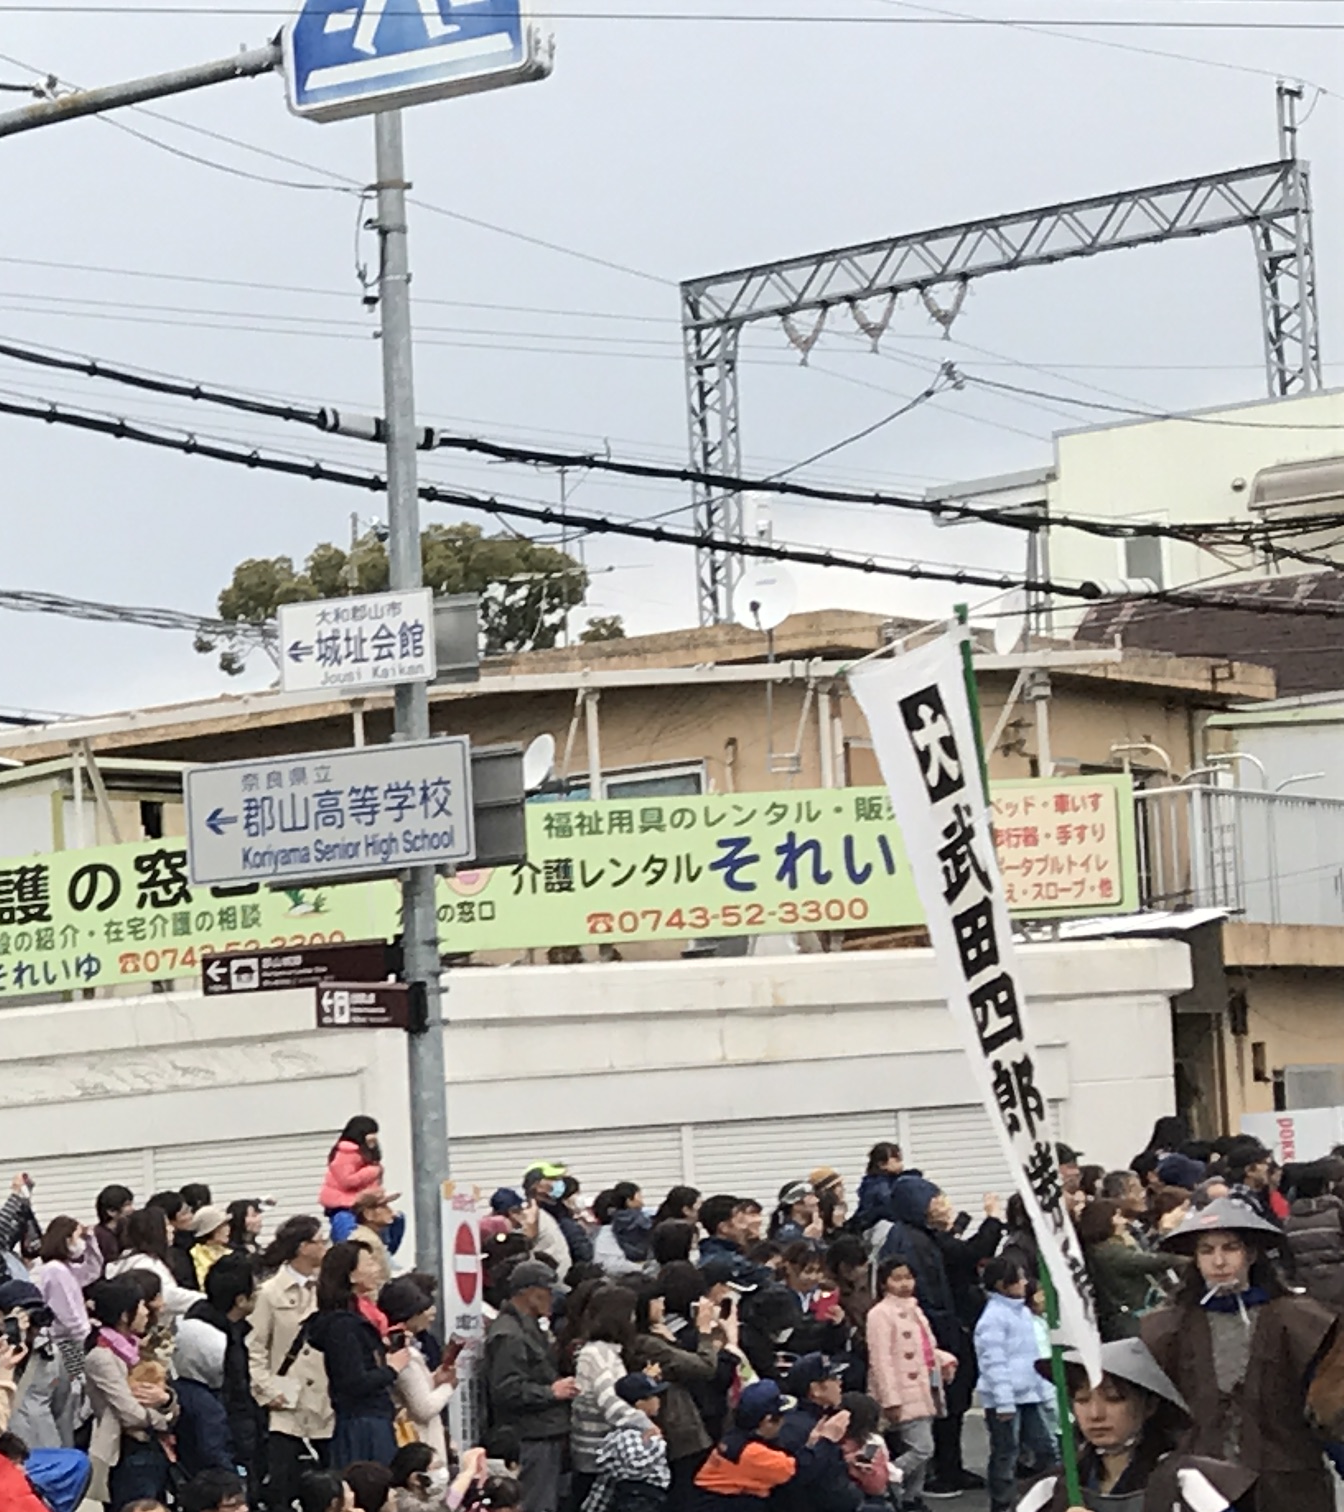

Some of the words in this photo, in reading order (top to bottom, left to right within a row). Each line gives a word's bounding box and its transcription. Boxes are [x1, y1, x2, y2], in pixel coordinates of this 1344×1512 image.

[315, 600, 403, 626] 大和郡山市
[315, 619, 425, 667] 城址会館
[241, 764, 333, 793] 奈良県立
[242, 776, 453, 838] 郡山高等学校
[241, 846, 311, 874] Koriyama
[313, 837, 361, 862] Senior
[364, 831, 399, 863] High
[402, 824, 455, 852] School
[709, 831, 897, 892] それい
[616, 897, 869, 934] 0743-52-3300
